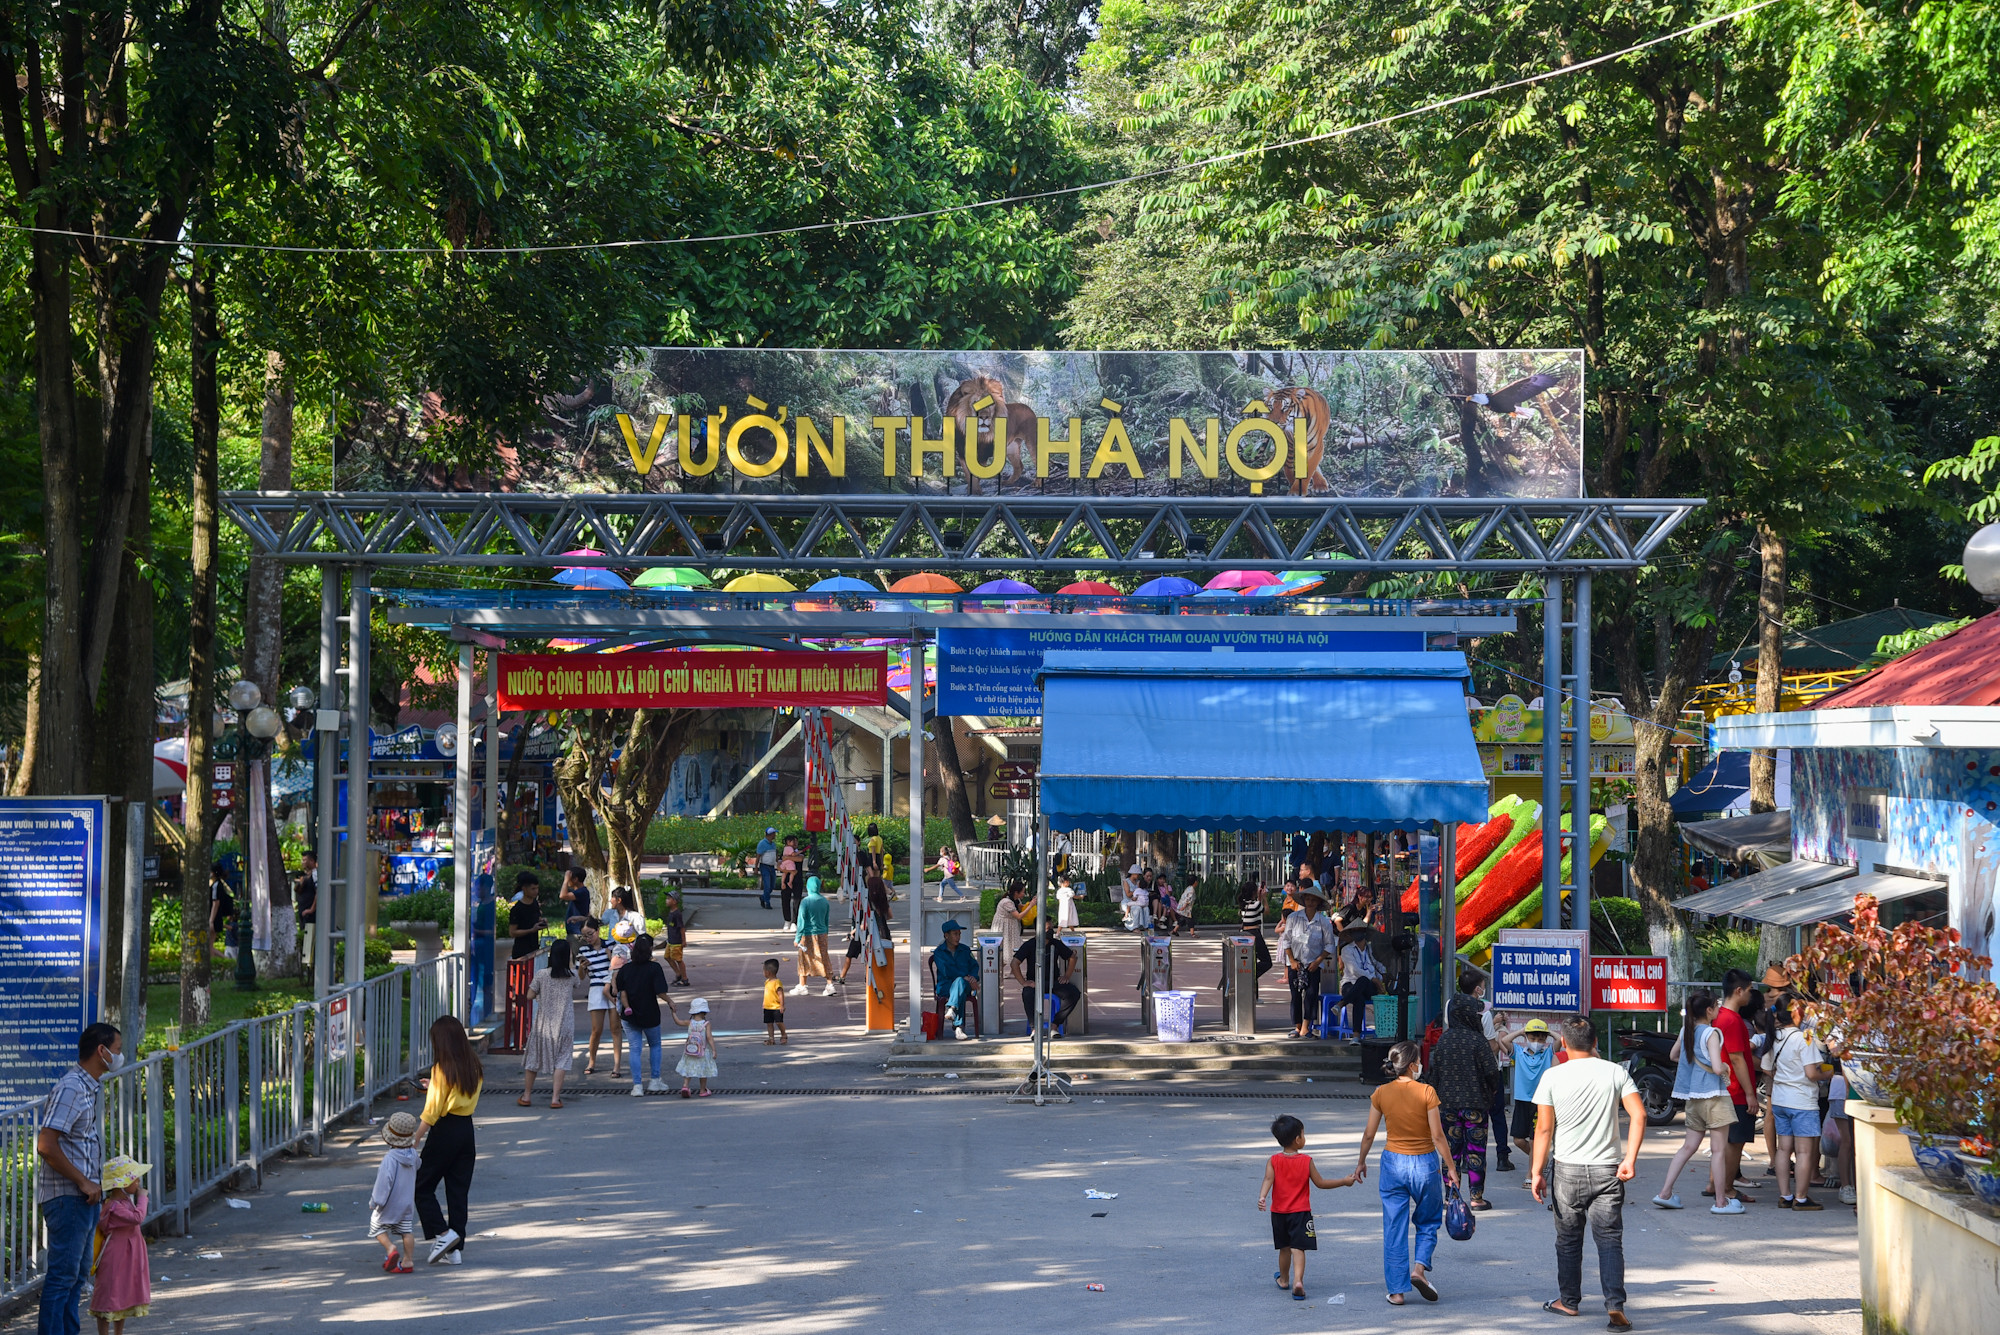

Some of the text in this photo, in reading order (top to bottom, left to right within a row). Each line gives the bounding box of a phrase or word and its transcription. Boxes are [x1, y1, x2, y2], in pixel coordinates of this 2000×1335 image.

[616, 395, 1307, 494] VƯỜN THÚ HÀ NỘI
[1029, 630, 1328, 647] HƯỚNG DẪN KHÁCH THAM QUAN VƯỜN THÚ HÀ NỘI
[507, 661, 878, 700] NƯỚC CỘNG HÒA XÃ HỘI CHỦ NGHĨA VIỆT NAM MUÔN NĂM!
[1601, 714, 1607, 724] 1
[14, 820, 33, 830] VƯỜN
[36, 820, 48, 830] THÚ
[50, 820, 60, 830] HÀ
[62, 820, 74, 830] NỘI
[1501, 953, 1512, 965] XE
[1514, 953, 1531, 965] TAXI
[1503, 969, 1570, 986] ĐÓN TRẢ KHÁCH
[1594, 959, 1663, 981] CẤM DẮT, THẢ CHÓ
[1496, 990, 1576, 1006] KHÔNG QUÁ 5 PHÚT
[1602, 985, 1656, 1004] VÀO VƯỜN THÚ
